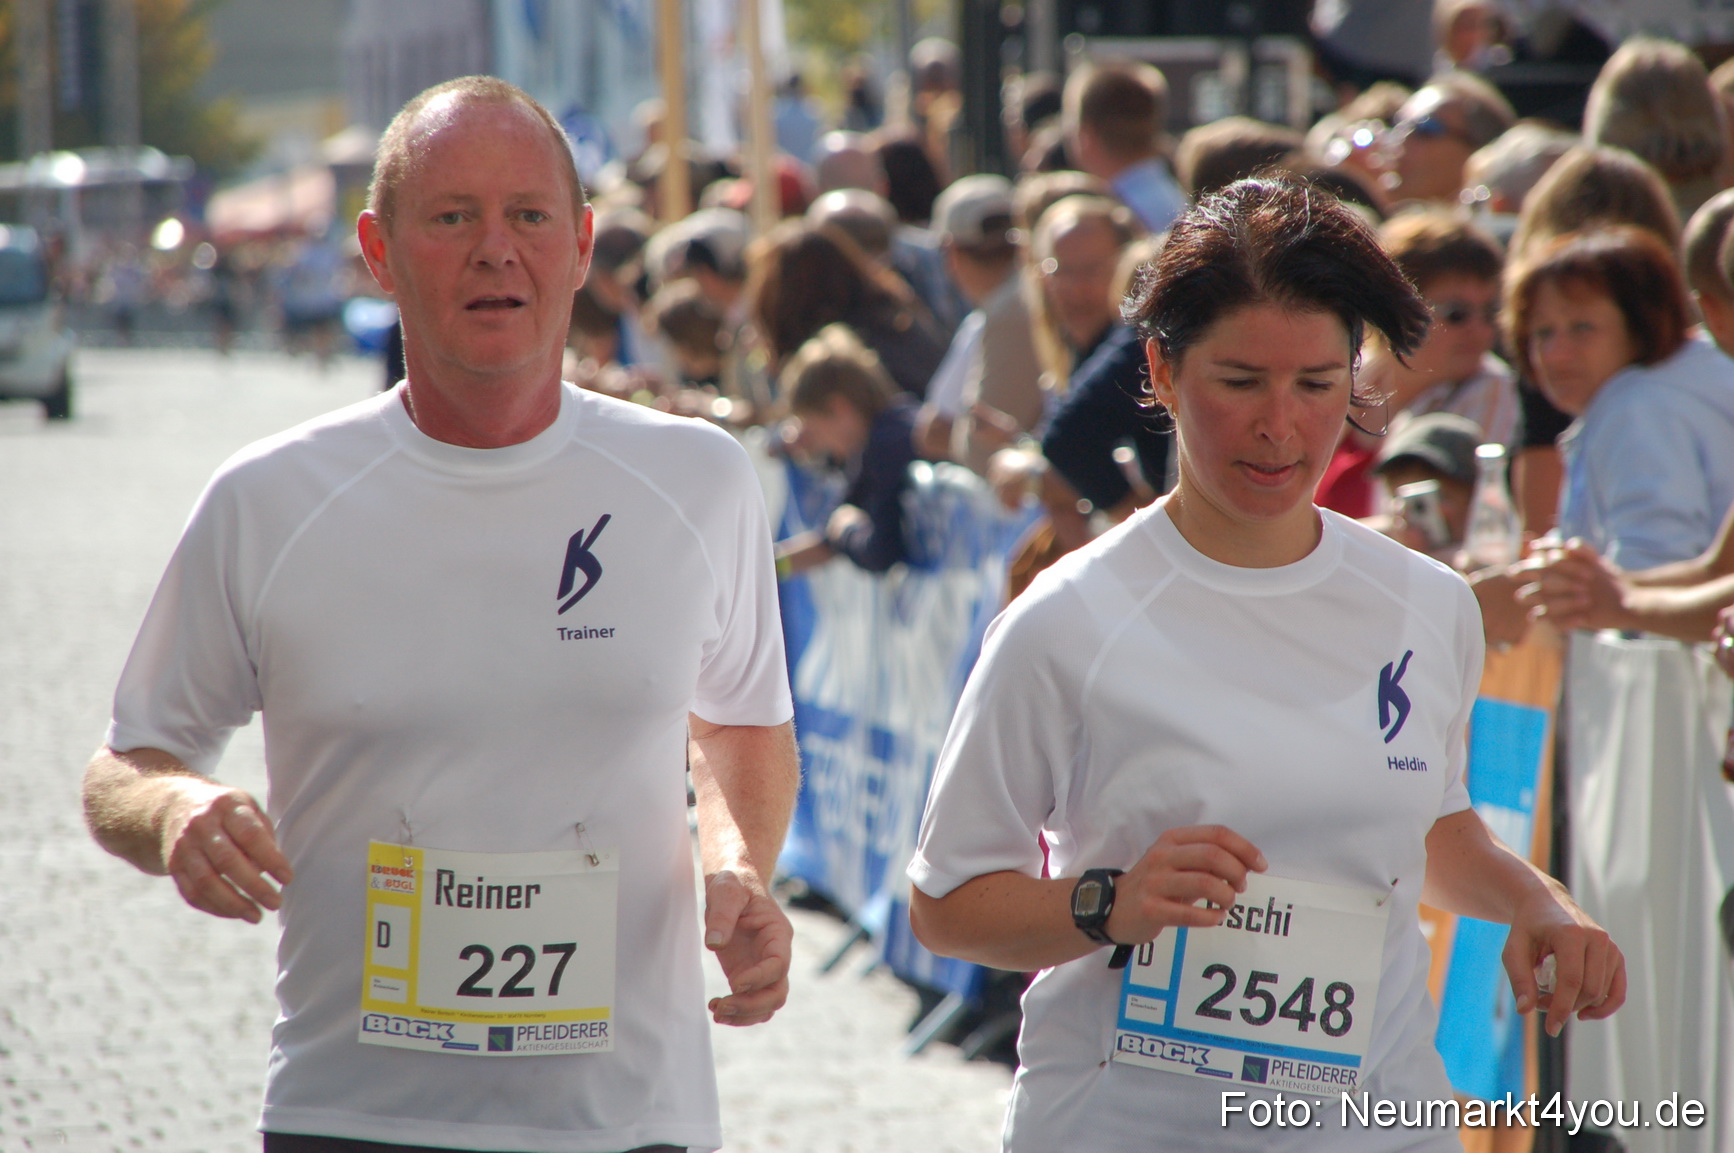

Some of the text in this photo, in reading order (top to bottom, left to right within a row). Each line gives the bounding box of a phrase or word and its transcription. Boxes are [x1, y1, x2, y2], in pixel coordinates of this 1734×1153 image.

[557, 626, 615, 640] Trainer
[1387, 756, 1427, 771] Heldin
[435, 868, 541, 909] Reiner
[1206, 896, 1294, 937] schi
[377, 920, 391, 948] D
[456, 942, 577, 998] 227
[1195, 963, 1355, 1037] 2548
[363, 1014, 455, 1041] BOCK
[517, 1022, 608, 1041] PFLEIDERER
[517, 1040, 608, 1051] AKTIENGESELLSCHAFT
[1117, 1034, 1210, 1066] BOCK
[1271, 1059, 1358, 1086] PFLEIDERER
